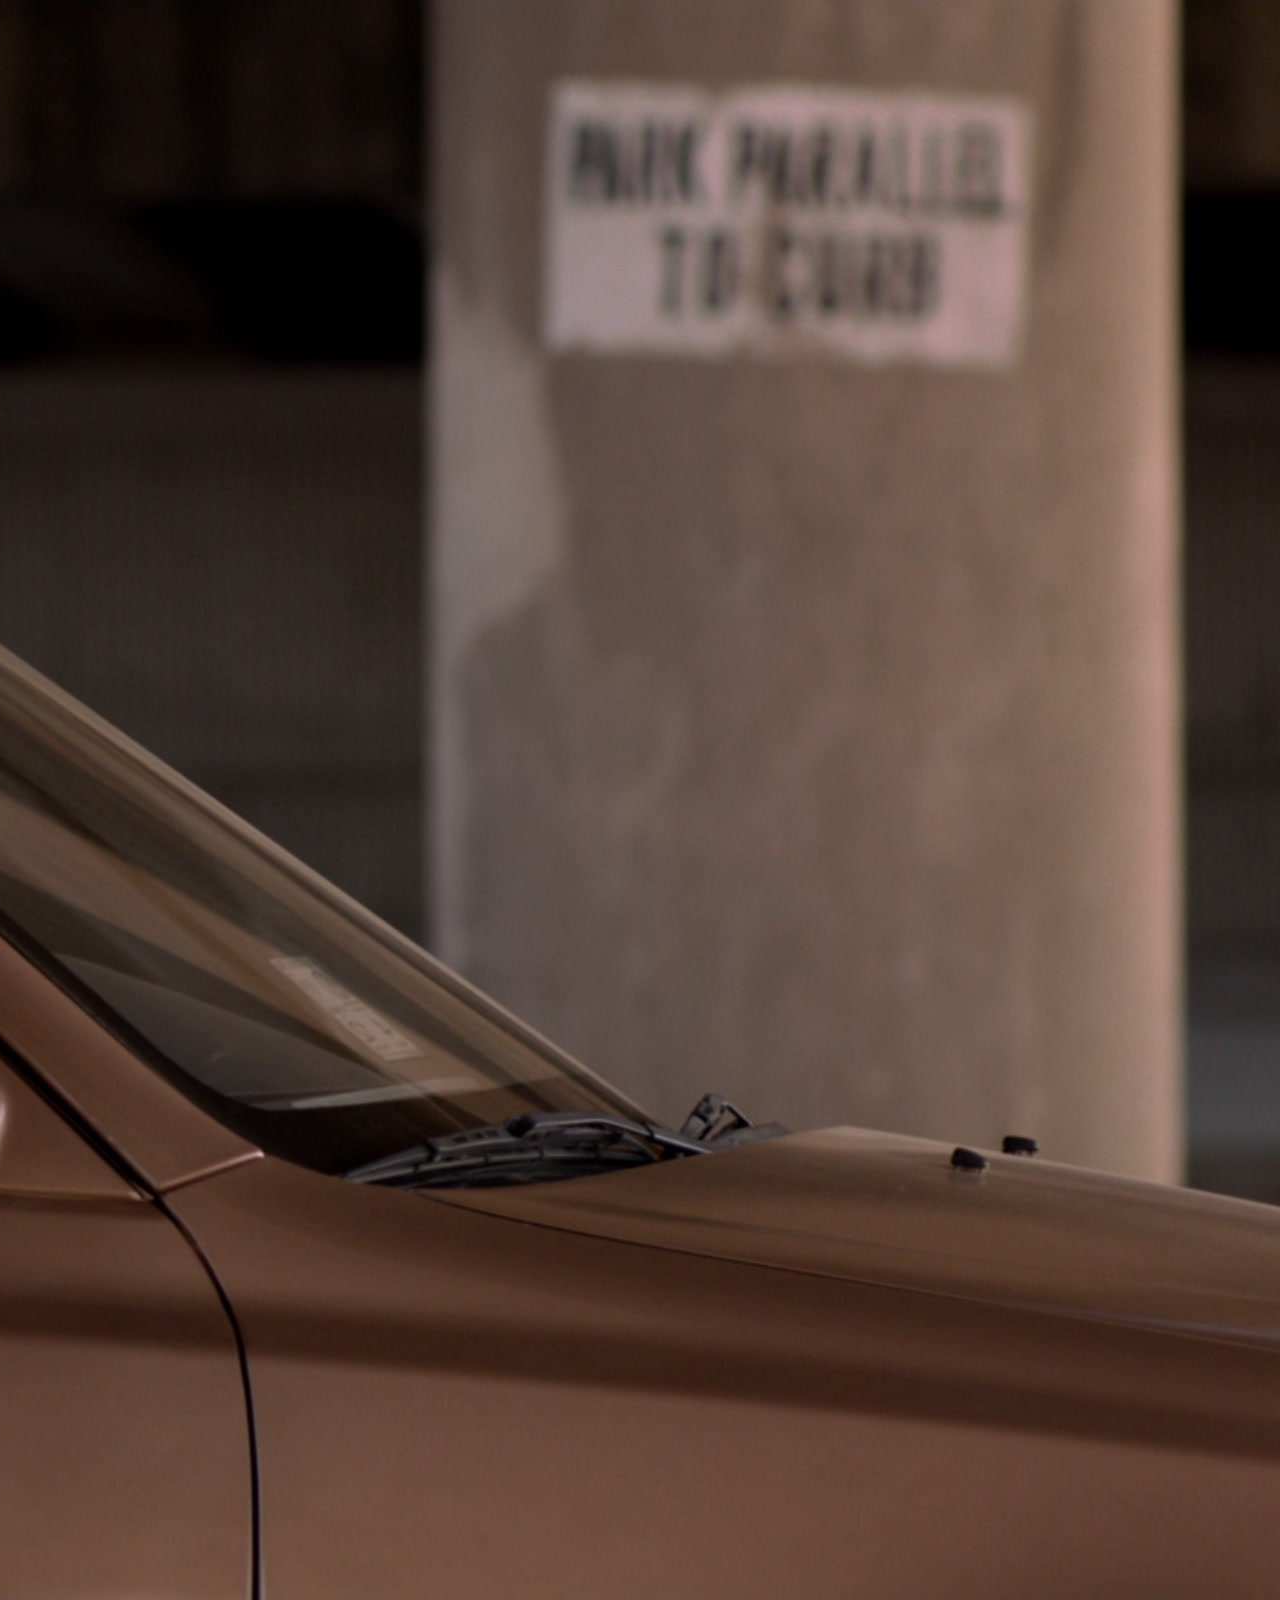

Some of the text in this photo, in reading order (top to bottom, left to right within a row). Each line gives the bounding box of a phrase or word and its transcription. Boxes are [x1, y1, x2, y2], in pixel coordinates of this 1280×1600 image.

[568, 121, 1007, 220] PARK PARALLEL
[660, 226, 940, 320] TO CURB
